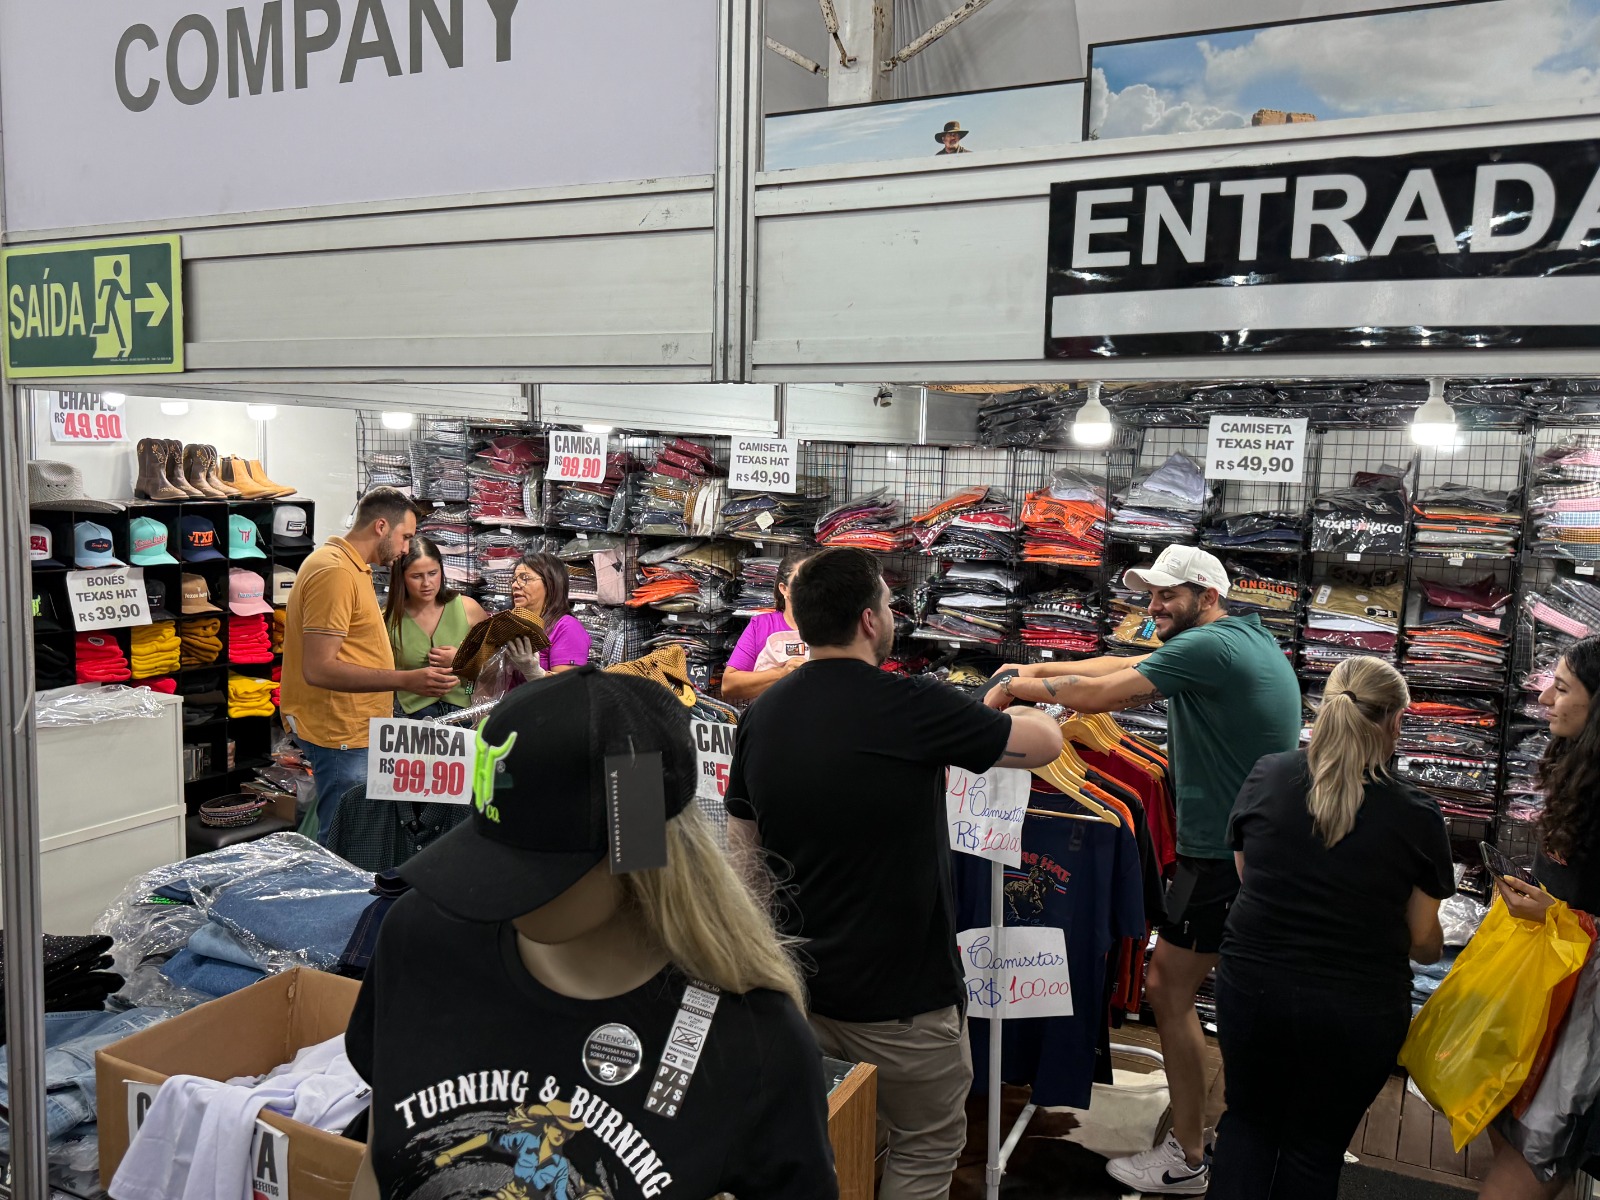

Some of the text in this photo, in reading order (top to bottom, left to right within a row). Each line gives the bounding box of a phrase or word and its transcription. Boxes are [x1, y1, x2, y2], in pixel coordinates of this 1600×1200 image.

[114, 0, 519, 112] COMPANY
[10, 268, 86, 339] SAÍDA
[55, 412, 122, 440] R$ 49,90
[1221, 422, 1292, 434] CAMISETA
[555, 435, 600, 455] CAMISA
[739, 442, 787, 453] CAMISETA
[1216, 438, 1294, 450] TEXAS HAT
[561, 456, 601, 478] 99,90
[736, 455, 789, 466] TEXAS HAT
[1237, 456, 1294, 475] 49,90
[751, 470, 790, 486] 49,90
[87, 573, 125, 587] BONÉS
[76, 589, 137, 602] TEXAS HAT
[96, 604, 140, 621] 39,90
[379, 724, 466, 757] CAMISA
[379, 758, 465, 797] R$ 99,90
[703, 761, 715, 777] R$
[951, 770, 967, 813] 4
[981, 827, 1020, 852] 100,00
[967, 936, 1064, 969] Camisetas
[1009, 976, 1069, 1004] 100,00
[596, 1033, 634, 1046] ATENÇÃO!
[602, 1046, 620, 1054] PASSAR
[620, 1050, 636, 1058] FERRO
[610, 1056, 632, 1065] ESTAMPA
[394, 1070, 673, 1200] TURNING & BURNING
